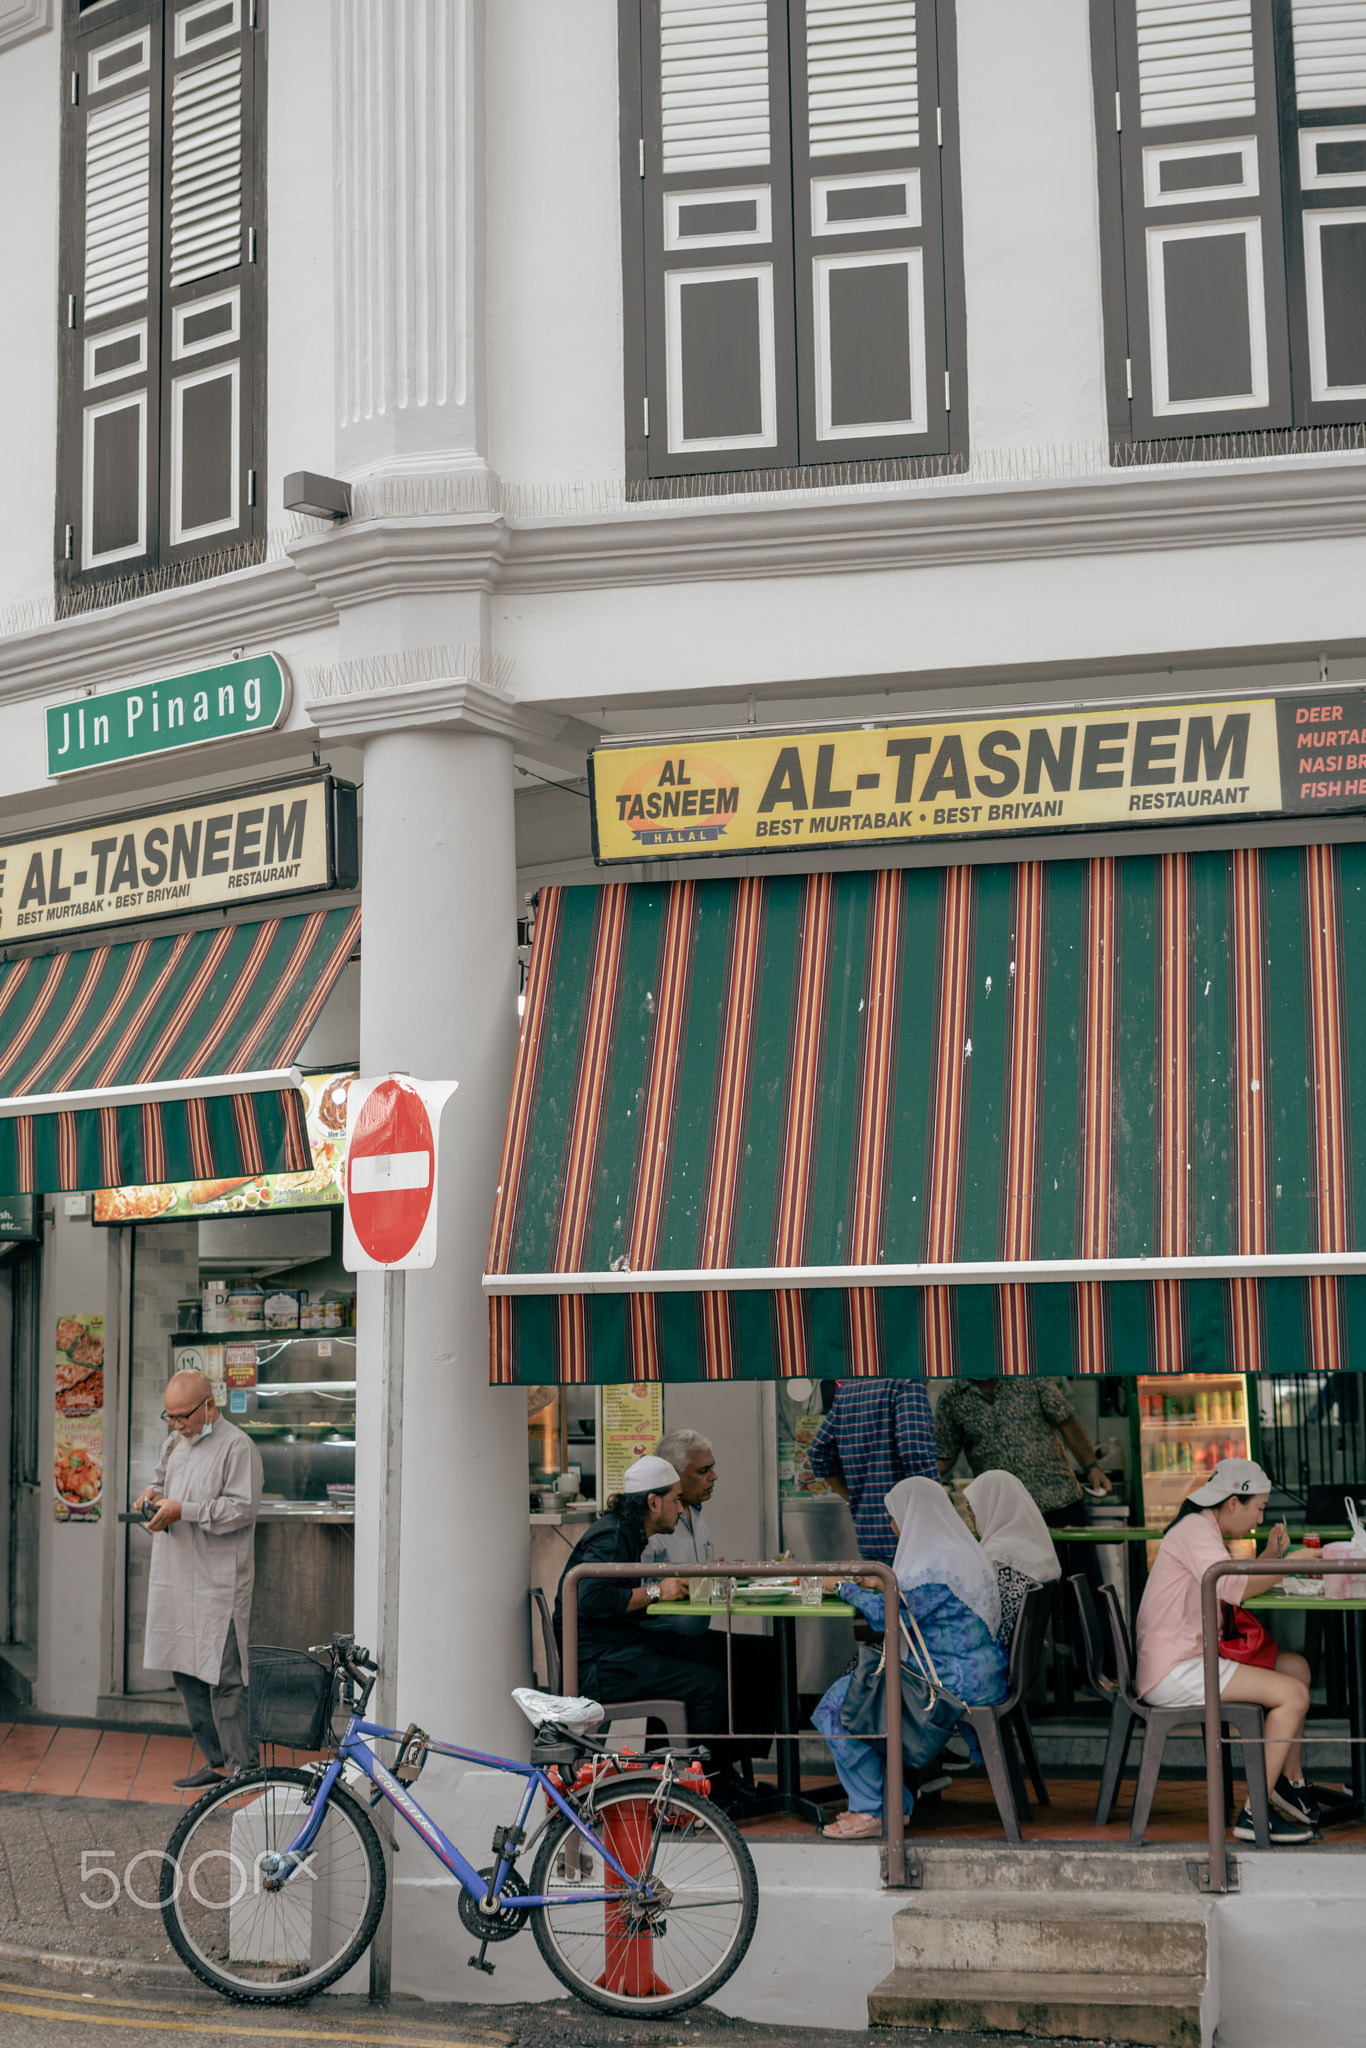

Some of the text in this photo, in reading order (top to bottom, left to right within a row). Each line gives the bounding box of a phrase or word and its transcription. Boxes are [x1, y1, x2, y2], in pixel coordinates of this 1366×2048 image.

[58, 677, 261, 755] Jln Pinang
[1295, 705, 1343, 724] DEER
[658, 759, 691, 787] AL
[757, 712, 1251, 814] AL-TASNEEM
[1299, 755, 1343, 773] NASI
[1129, 786, 1250, 811] RESTAURANT
[1300, 780, 1342, 799] FISH
[616, 786, 739, 821] TASNEEM
[756, 799, 1063, 837] BEST MURTABAK BEST BRIYANI
[654, 830, 706, 844] HALAL
[18, 799, 308, 910] AL-TASNEEM
[228, 863, 301, 889] RESTAURANT
[17, 909, 43, 926] BEST
[46, 900, 104, 921] MURTABAK
[115, 891, 143, 909] BEST
[146, 883, 190, 904] BRIYANI
[1241, 1480, 1250, 1492] 6
